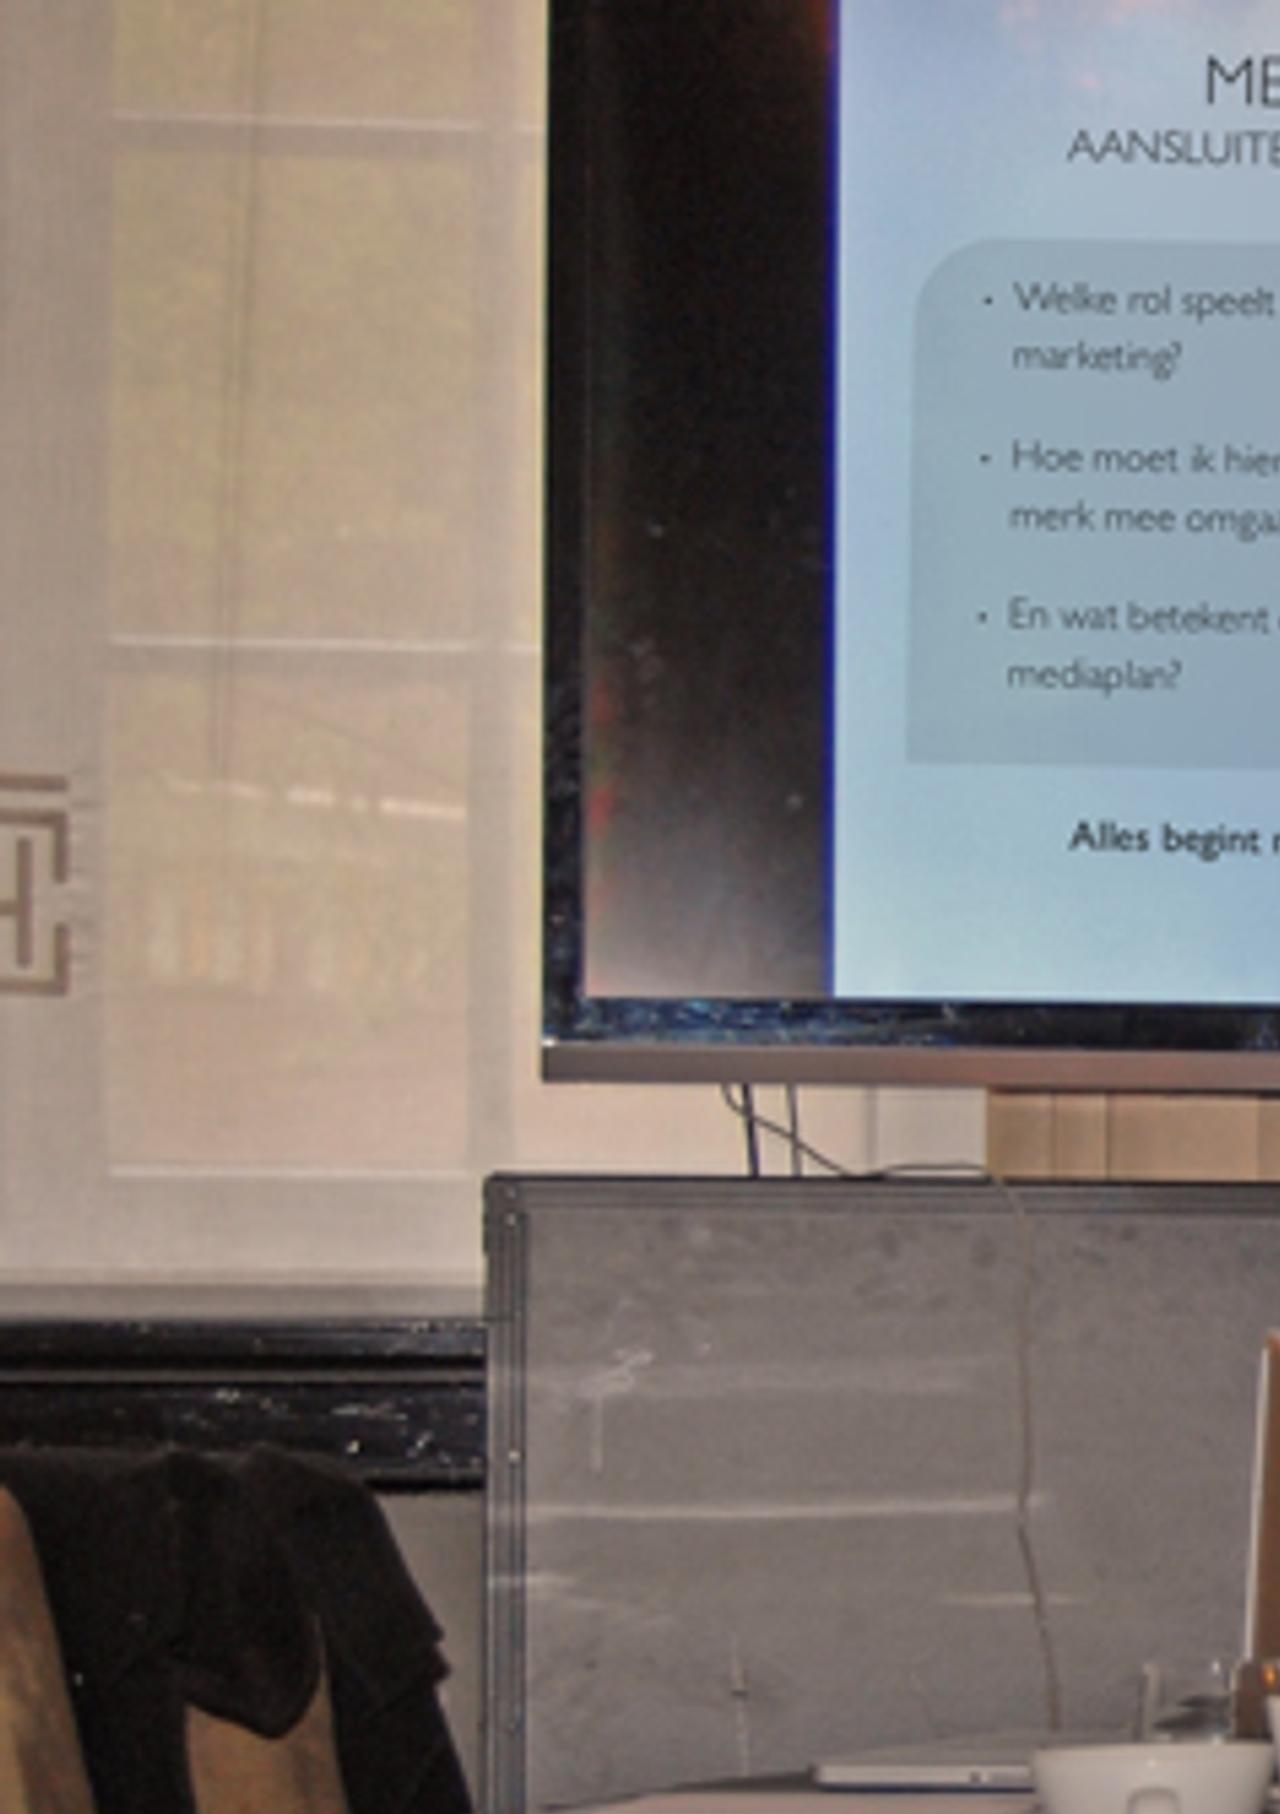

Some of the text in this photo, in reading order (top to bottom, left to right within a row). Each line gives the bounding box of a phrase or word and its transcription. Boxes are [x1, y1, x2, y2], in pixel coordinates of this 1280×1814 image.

[1013, 280, 1119, 317] Welke
[1127, 285, 1172, 317] rol
[1181, 287, 1276, 323] speelt
[1012, 339, 1184, 381] marketing?
[1011, 439, 1084, 473] Hoe
[1093, 443, 1179, 474] moet
[1191, 443, 1216, 473] ik
[1009, 500, 1096, 533] merk
[1104, 507, 1177, 533] mee
[1007, 596, 1050, 631] En
[1060, 602, 1120, 631] wat
[1127, 601, 1271, 636] betekent
[1007, 657, 1184, 696] mediaplan?
[1067, 820, 1150, 853] Alles
[1161, 821, 1261, 862] begint
